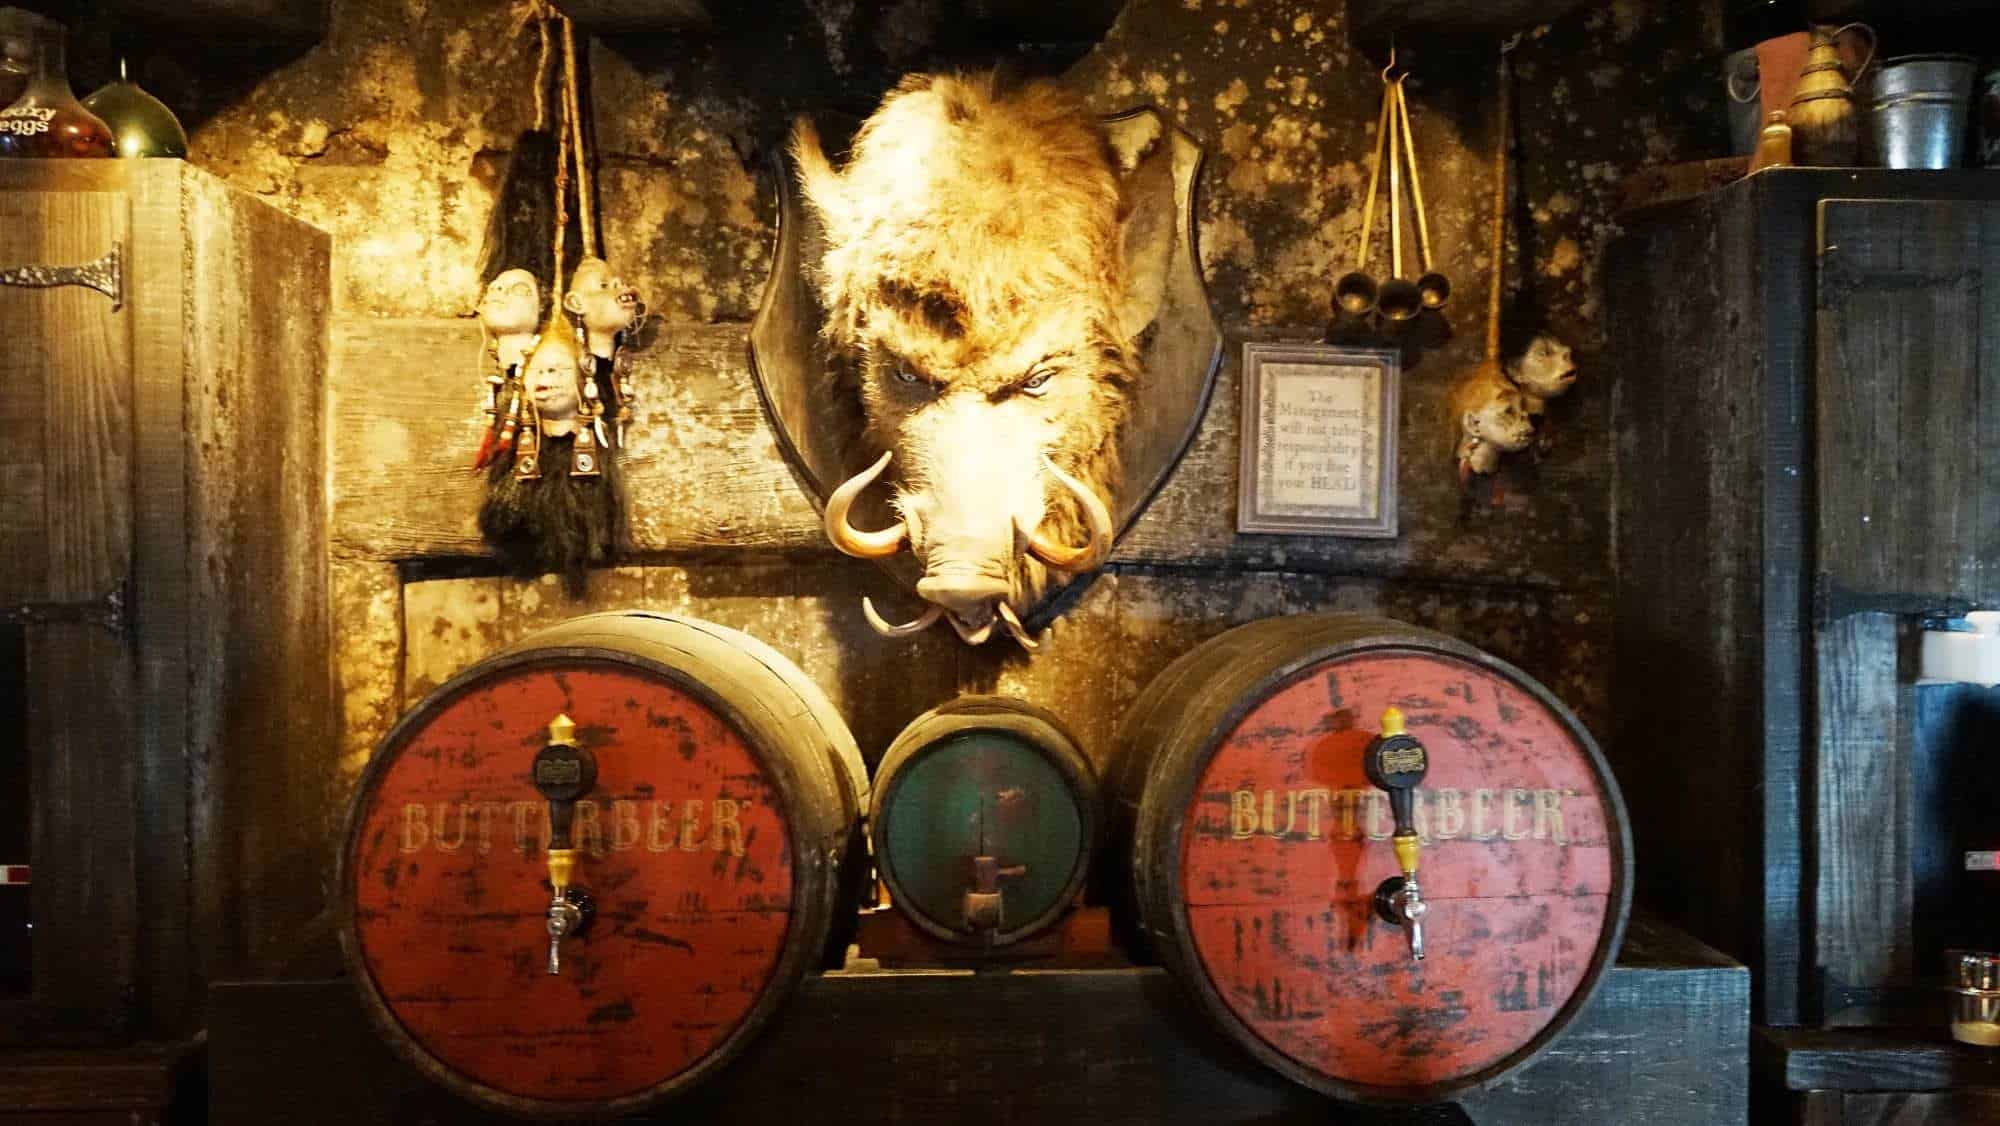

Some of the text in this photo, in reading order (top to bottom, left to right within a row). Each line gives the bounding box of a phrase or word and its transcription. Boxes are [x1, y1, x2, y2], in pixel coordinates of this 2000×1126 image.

[0, 119, 49, 136] eggs
[1279, 402, 1360, 422] Management
[1280, 421, 1303, 434] will
[1307, 424, 1327, 436] not
[1284, 456, 1295, 471] if
[1299, 462, 1323, 476] you
[1277, 479, 1305, 491] your
